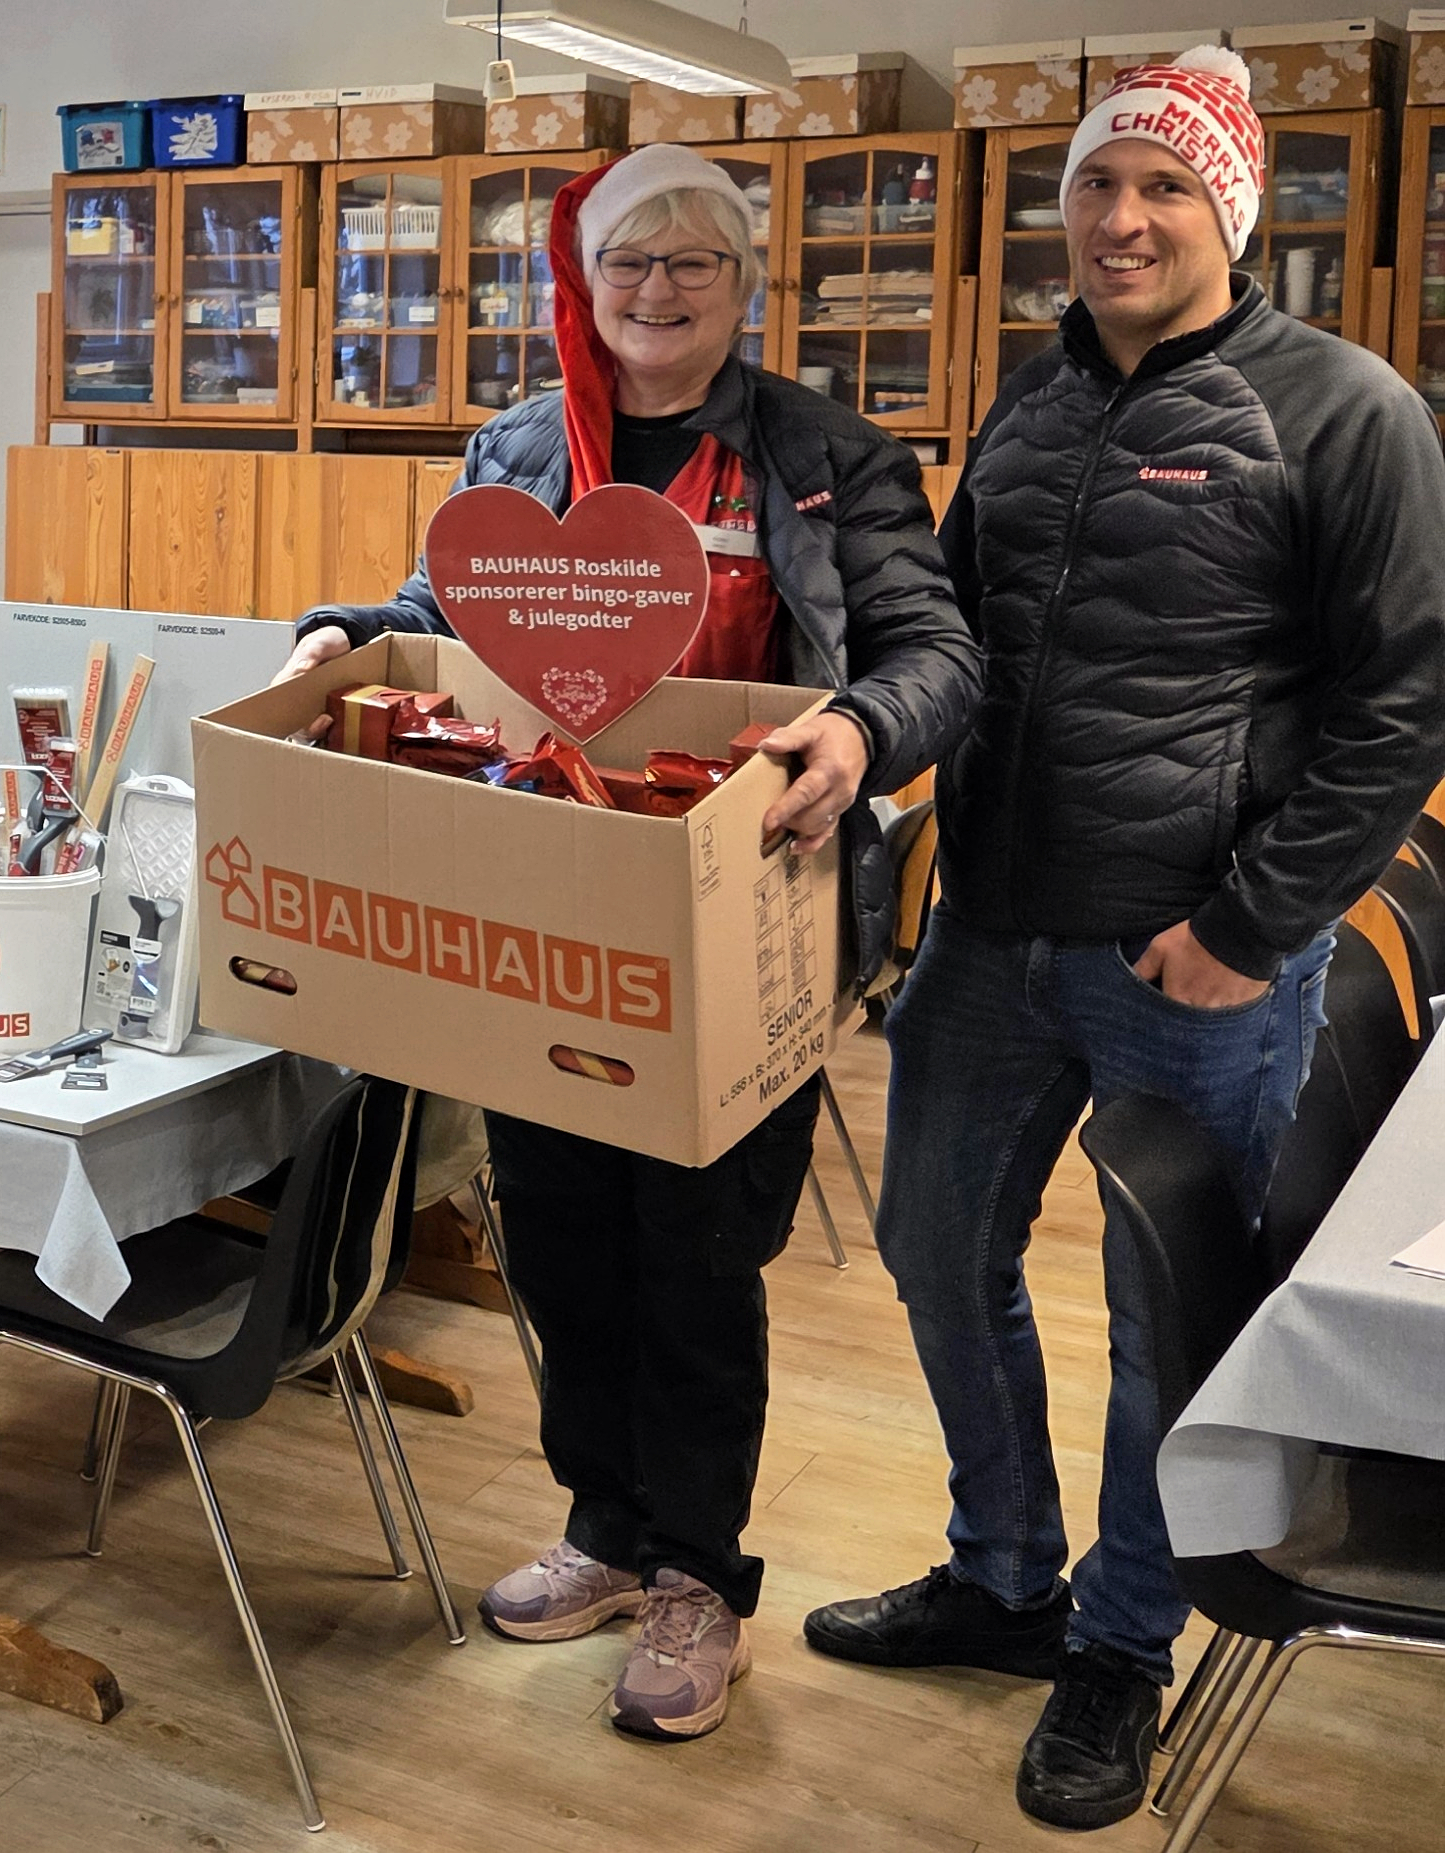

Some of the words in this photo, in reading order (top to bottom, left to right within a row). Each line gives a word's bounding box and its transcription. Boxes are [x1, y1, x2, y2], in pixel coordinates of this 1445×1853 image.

[1111, 112, 1246, 235] CHRISTMAS
[1162, 101, 1245, 187] MERRY
[795, 490, 832, 512] HAUS
[1148, 468, 1209, 481] BAUHAUS
[445, 585, 567, 604] sponsorerer
[572, 583, 693, 608] bingo-gaver
[470, 557, 570, 574] BAUHAUS
[574, 558, 662, 578] Roskilde
[508, 608, 524, 625] &
[528, 608, 633, 631] julegodter
[81, 659, 103, 739] BAUHAUS
[111, 673, 146, 751] BAUHAUS
[267, 870, 666, 1026] BAUHAUS
[766, 988, 814, 1047] SENIOR
[759, 1066, 791, 1105] Max.
[792, 1044, 808, 1073] 20
[809, 1031, 825, 1058] kg
